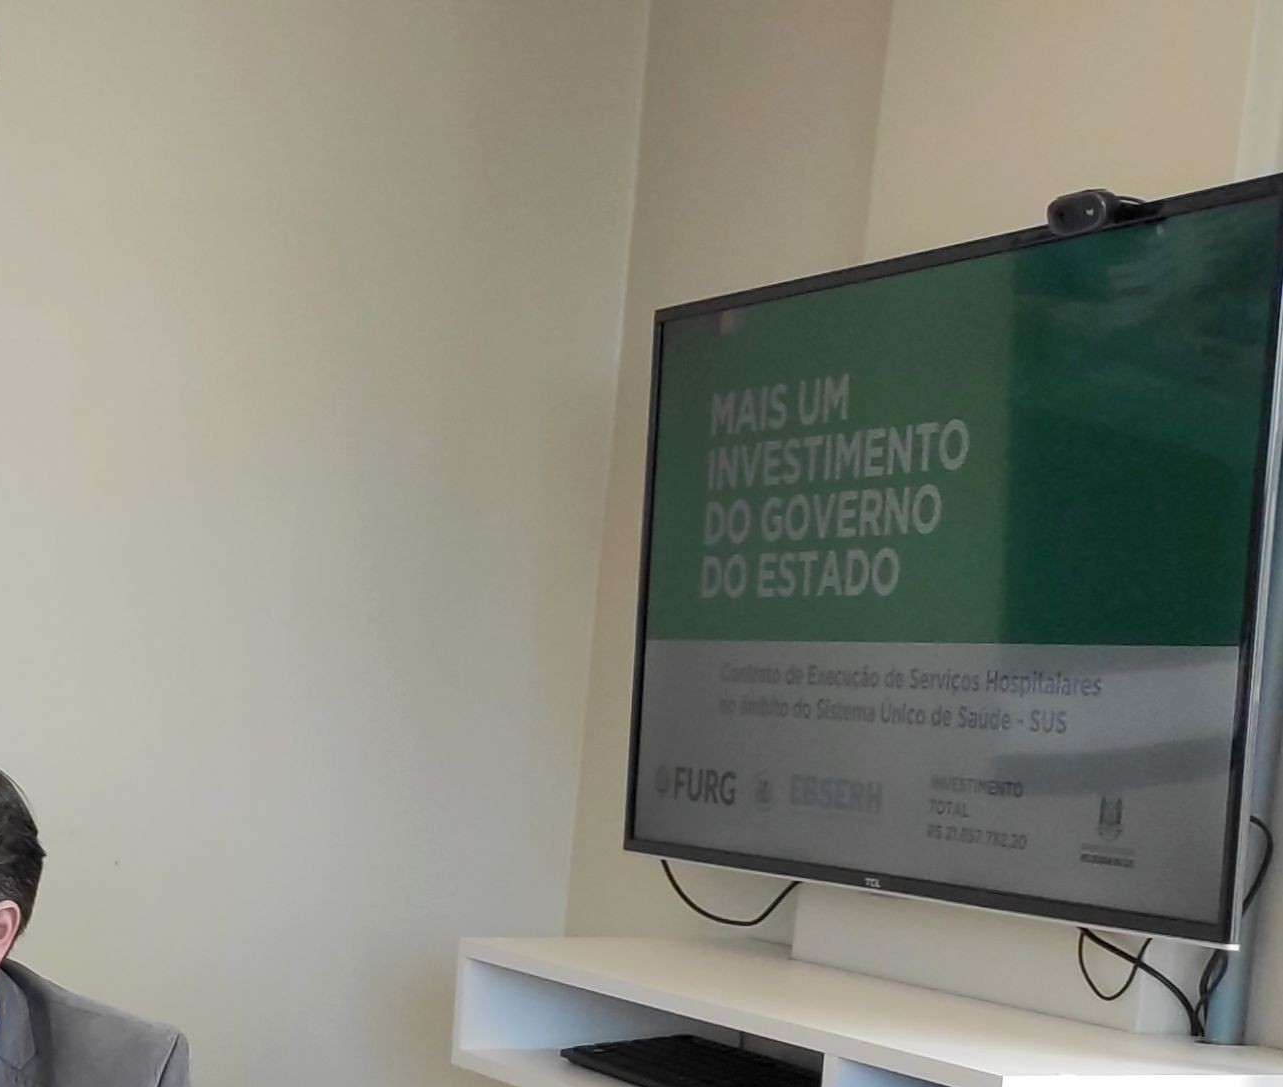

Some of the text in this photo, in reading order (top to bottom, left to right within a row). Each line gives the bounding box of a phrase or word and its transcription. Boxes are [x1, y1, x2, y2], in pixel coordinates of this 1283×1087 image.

[711, 373, 850, 436] MAIS UM
[707, 419, 970, 490] INVESTIMENTO
[703, 484, 942, 545] DO GOVERNO
[700, 546, 900, 598] DO ESTADO
[785, 665, 804, 686] de
[807, 665, 880, 689] Execução
[885, 665, 905, 689] de
[909, 667, 981, 694] Serviços
[985, 669, 1103, 698] Hospitalares
[793, 698, 812, 720] do
[816, 698, 876, 724] Sistema
[931, 705, 952, 727] de
[957, 705, 1011, 731] Saúde
[1029, 709, 1068, 734] SUS
[674, 766, 737, 806] FURG
[791, 774, 883, 814] EBSERH
[930, 774, 1024, 798] INVESTIMENTO
[929, 799, 969, 818] TOTAL
